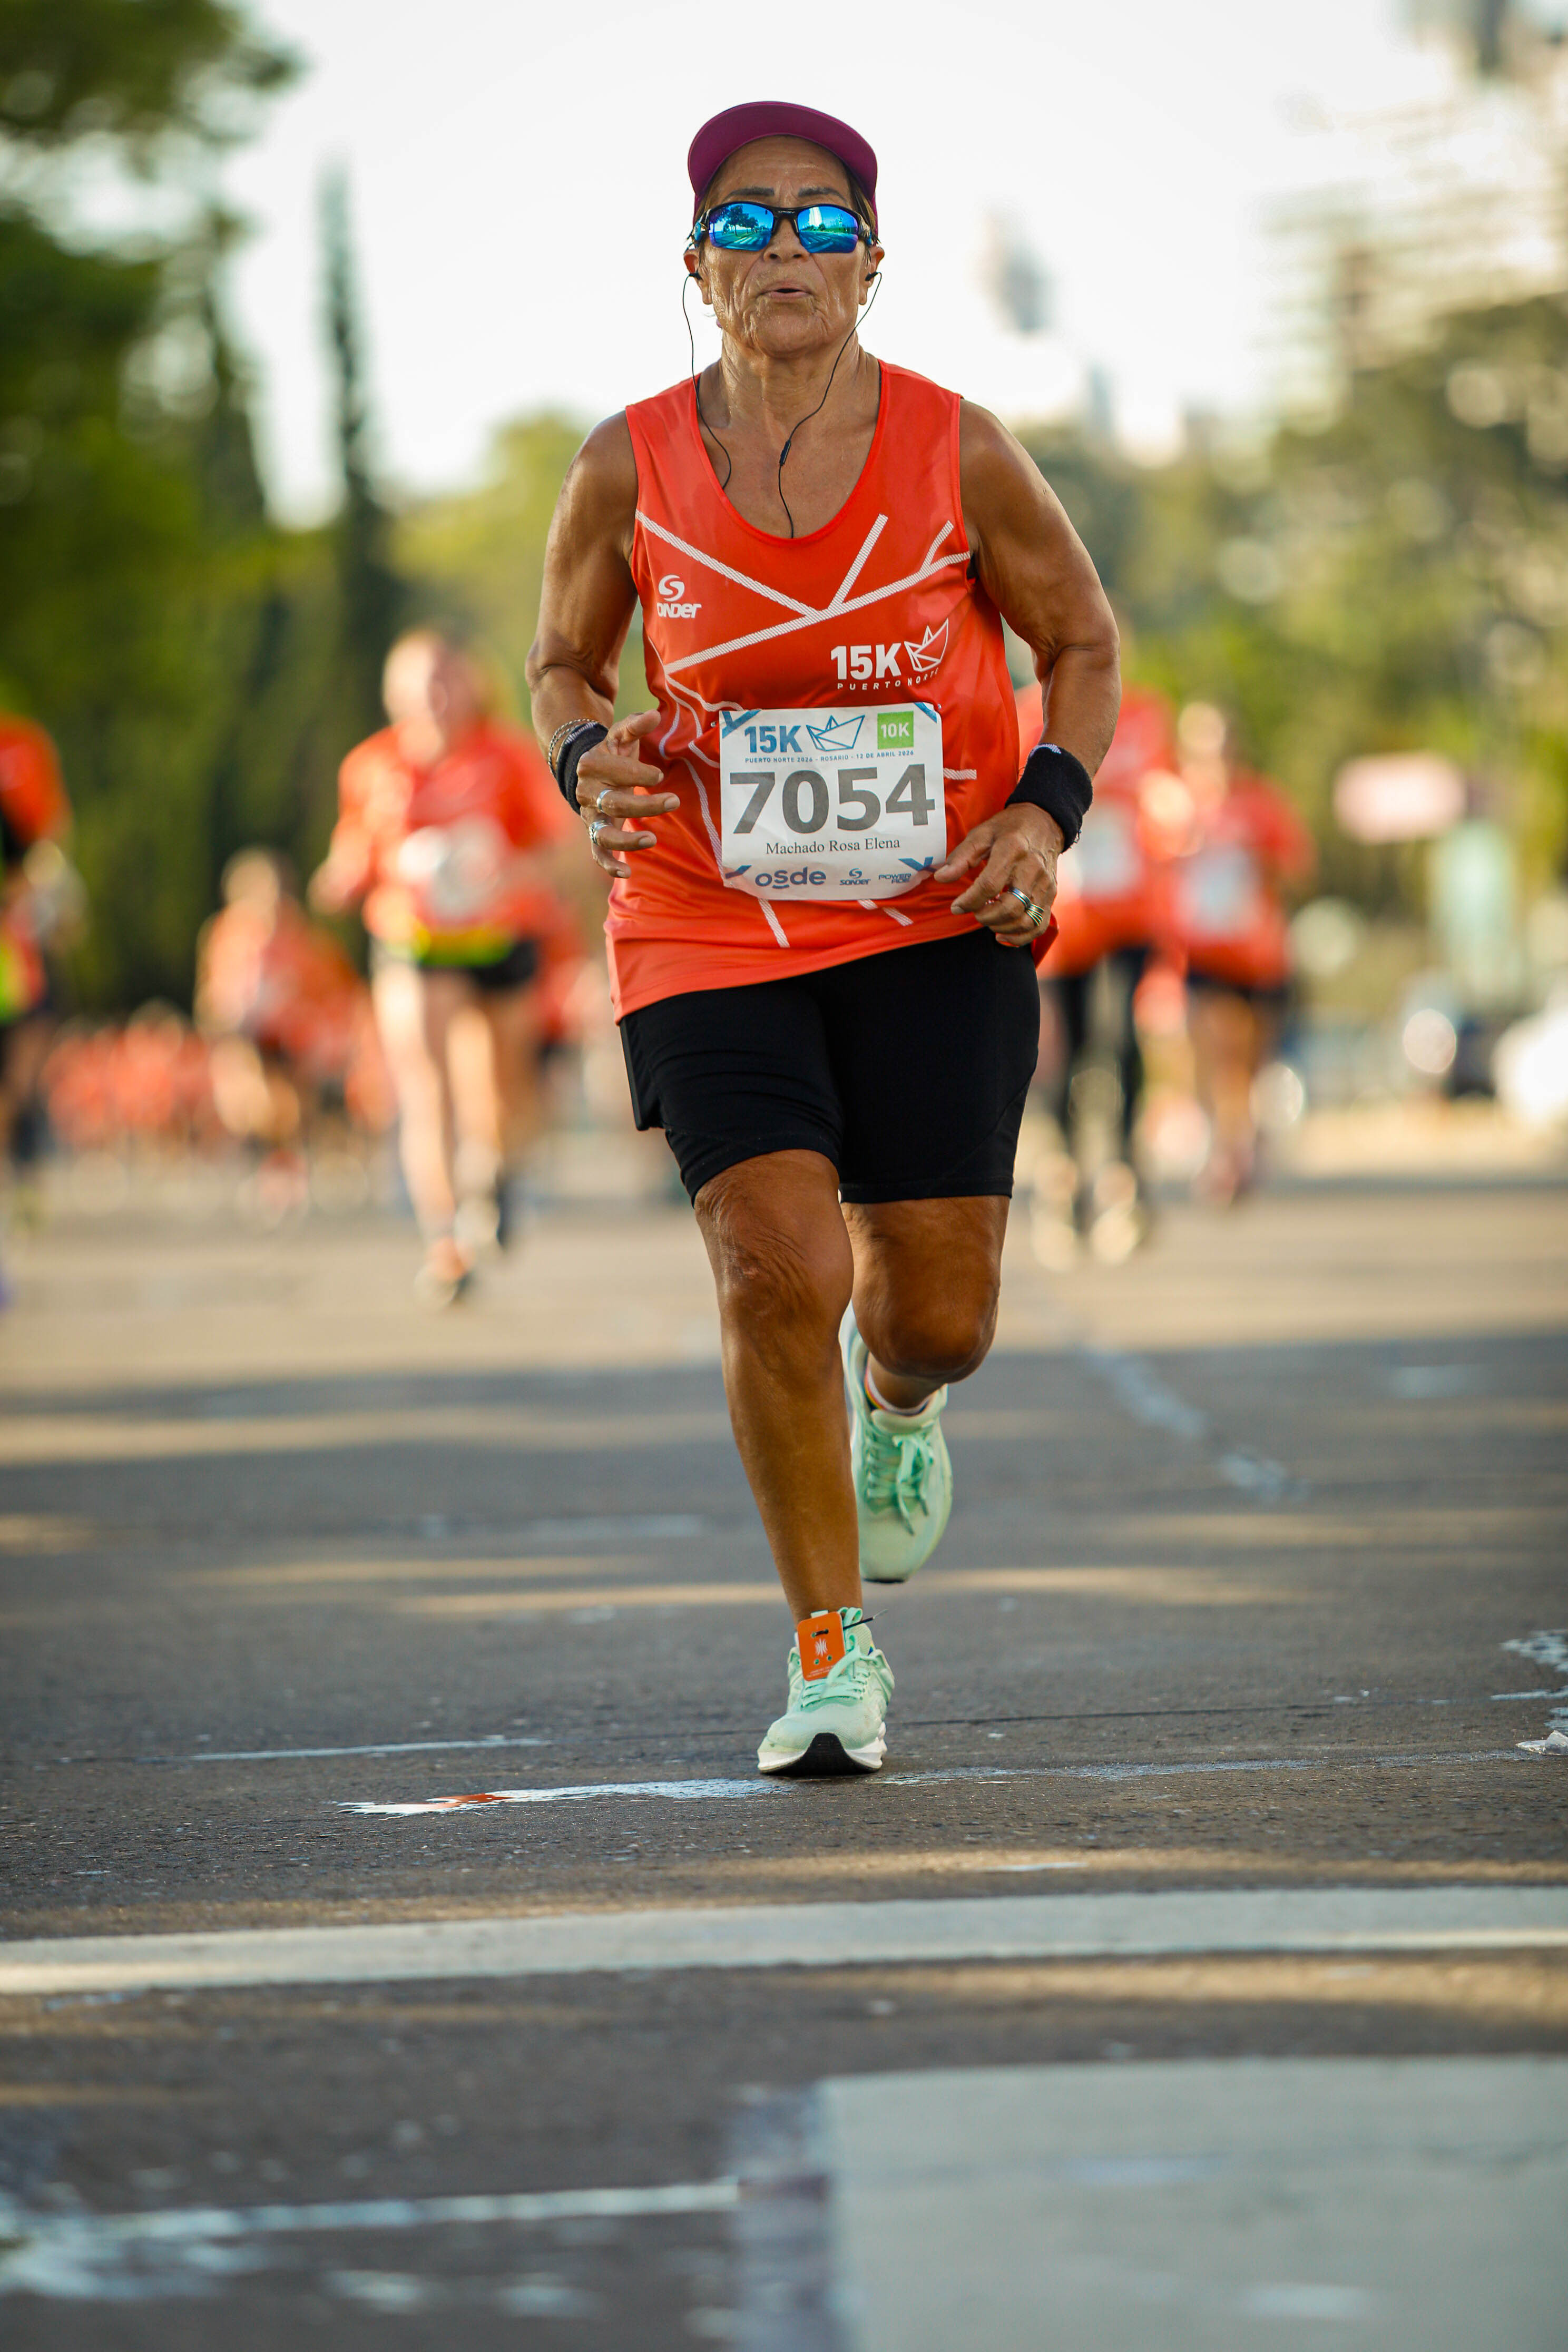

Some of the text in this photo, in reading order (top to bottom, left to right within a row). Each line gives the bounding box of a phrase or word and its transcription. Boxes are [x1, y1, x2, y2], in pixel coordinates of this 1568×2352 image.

[830, 642, 901, 680] 15K
[837, 667, 939, 690] PUERTO NORTE
[744, 725, 803, 753] 15K
[880, 722, 910, 739] 10K
[729, 763, 936, 835] 7054
[766, 837, 900, 855] Machado Rosa Elena
[754, 866, 827, 889] osde
